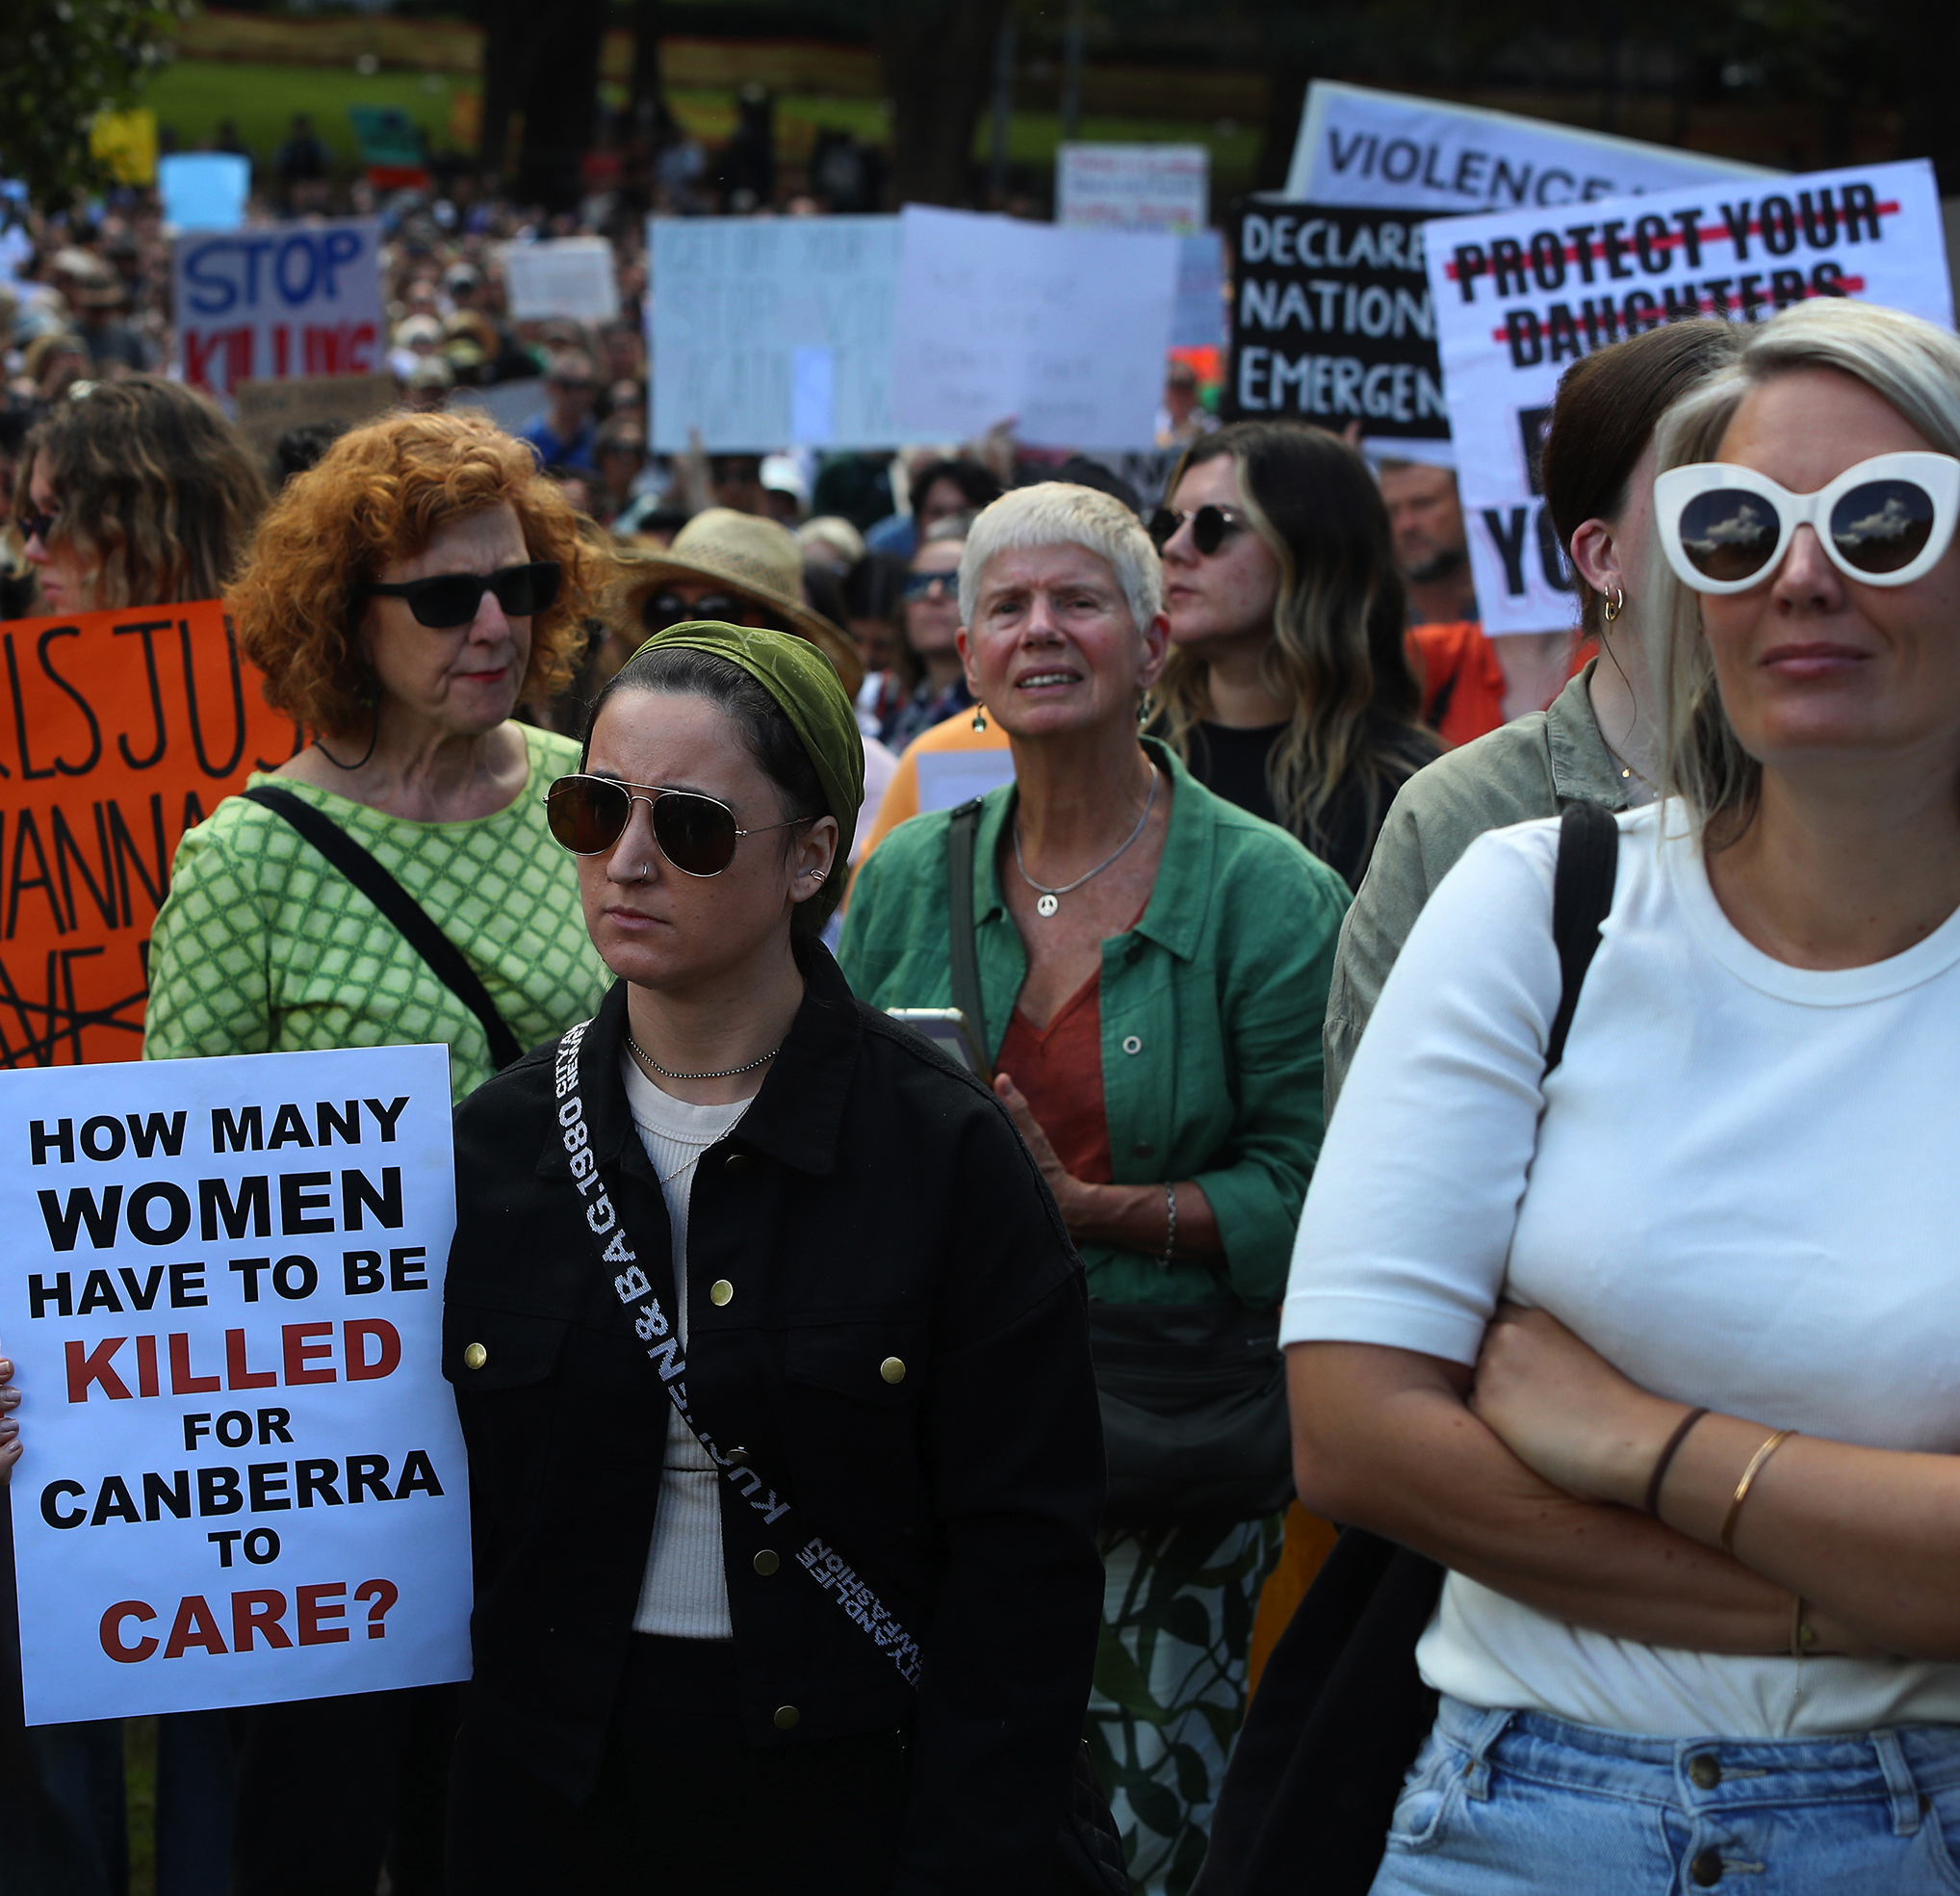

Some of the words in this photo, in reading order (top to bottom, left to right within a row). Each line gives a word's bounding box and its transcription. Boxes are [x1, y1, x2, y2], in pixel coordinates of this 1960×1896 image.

[184, 229, 365, 317] STOP
[1241, 213, 1427, 272] DECLARE
[1453, 209, 1704, 302] PROTECT
[1719, 183, 1882, 261] YOUR
[29, 1110, 188, 1166] HOW
[211, 1096, 411, 1154] MANY
[37, 1166, 404, 1252] WOMEN
[28, 1261, 208, 1319] HAVE
[228, 1255, 319, 1304] TO
[342, 1246, 429, 1296] BE
[64, 1317, 402, 1404] KILLED
[182, 1407, 295, 1451] FOR
[39, 1449, 445, 1529] CANBERRA
[208, 1527, 281, 1569] TO
[99, 1578, 400, 1664] CARE?
